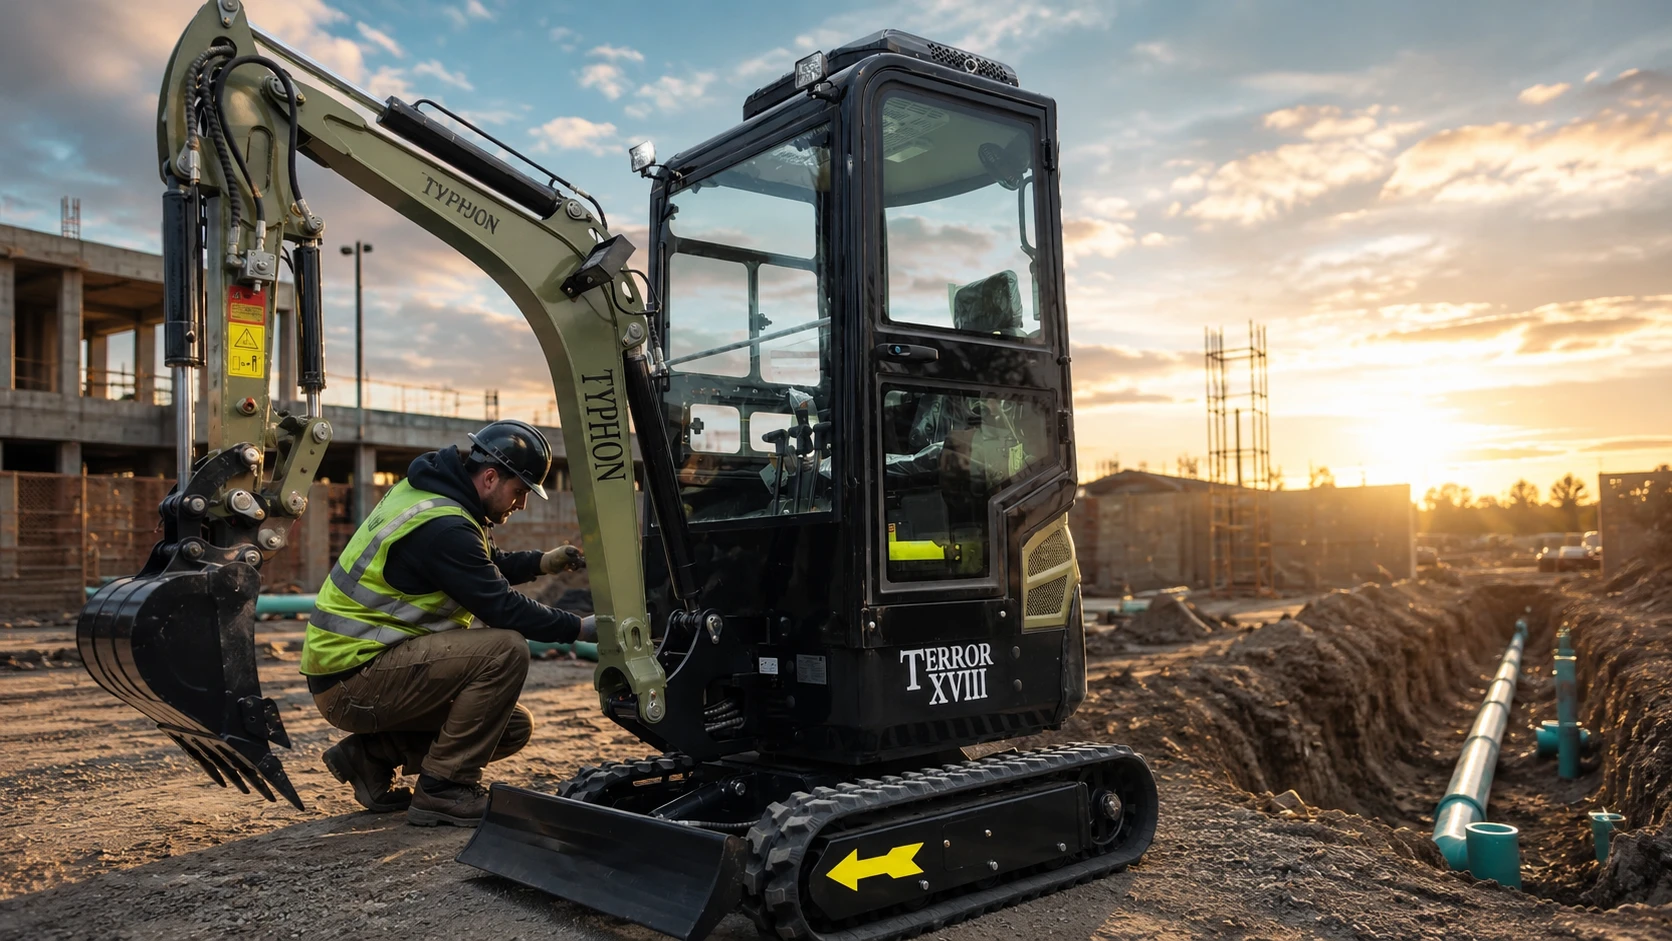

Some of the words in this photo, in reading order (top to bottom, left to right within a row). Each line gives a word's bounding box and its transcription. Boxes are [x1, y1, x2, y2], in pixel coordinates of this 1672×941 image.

[581, 369, 626, 482] TYPHON
[900, 643, 994, 691] TERROR
[928, 668, 988, 705] XVIII
